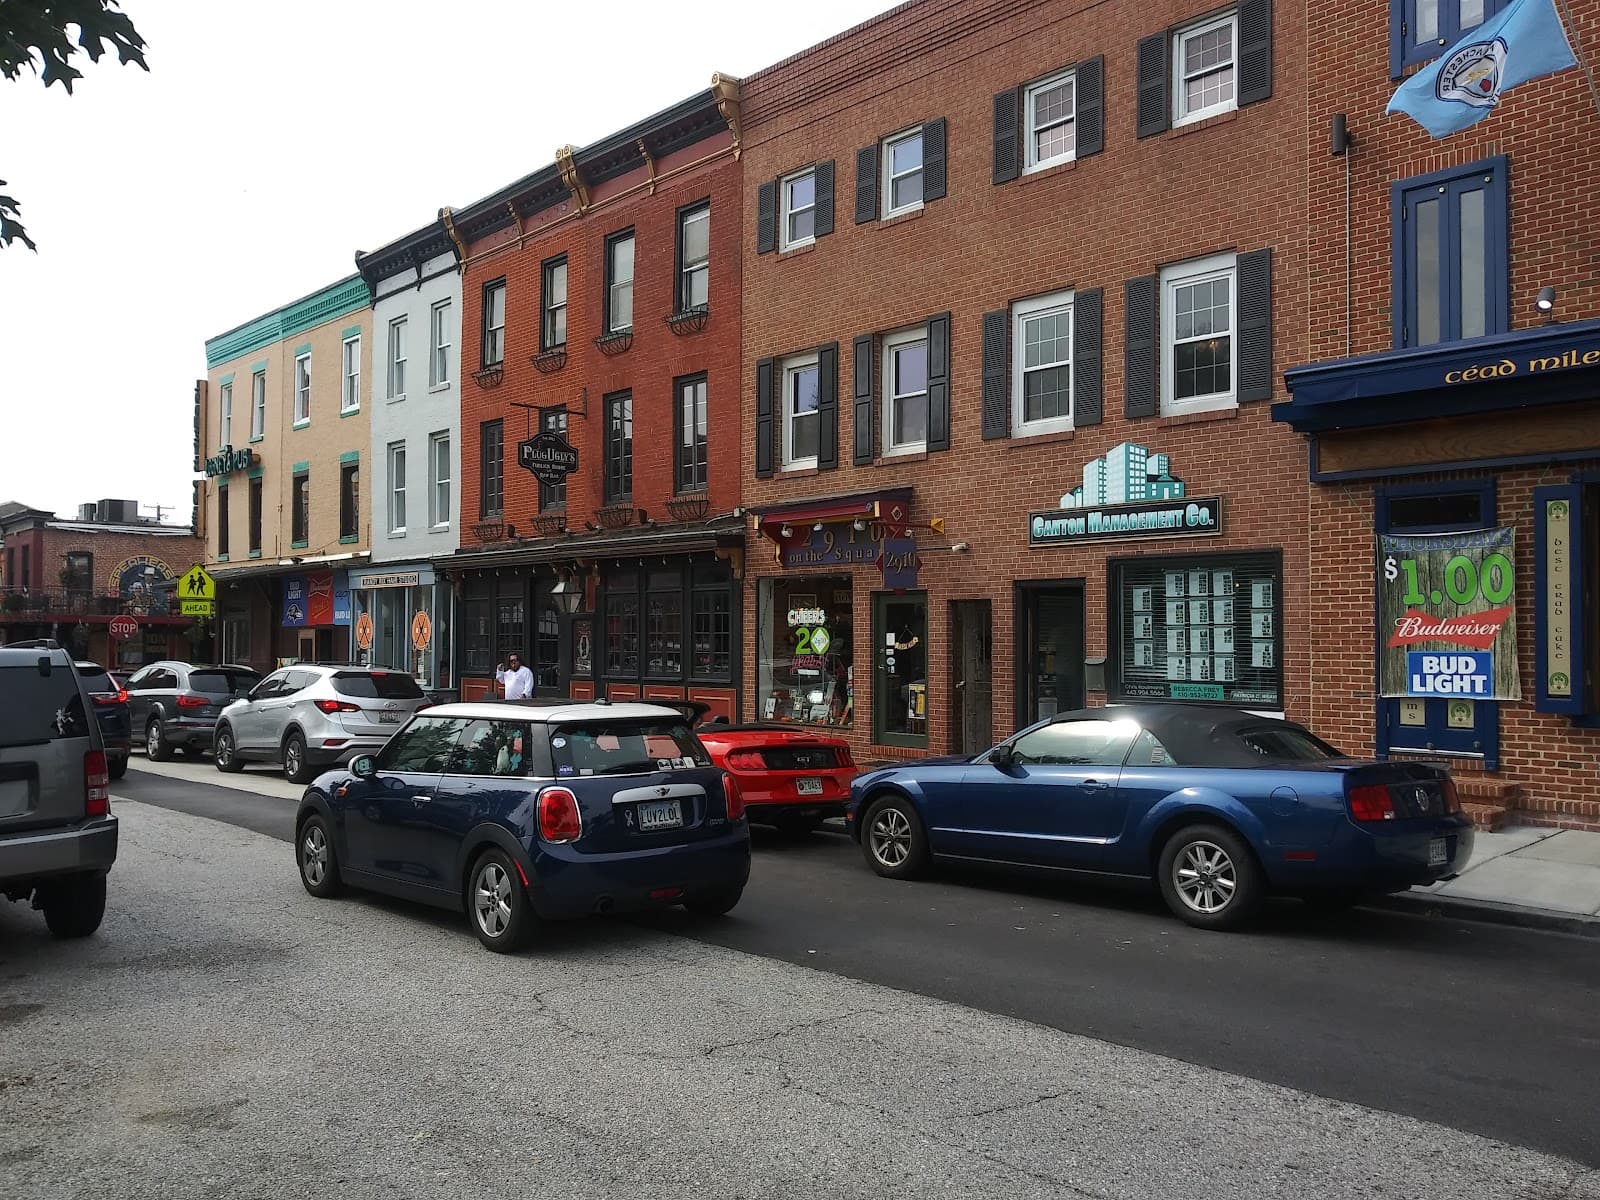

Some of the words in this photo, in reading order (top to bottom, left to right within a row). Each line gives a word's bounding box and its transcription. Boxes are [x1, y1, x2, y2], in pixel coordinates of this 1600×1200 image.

[232, 448, 250, 471] PUB
[1033, 516, 1085, 537] CANTON
[1087, 509, 1184, 533] MANAGEMENT
[789, 553, 802, 563] on
[805, 550, 823, 562] the
[886, 552, 916, 574] 2910
[287, 590, 302, 600] LIGHT
[184, 604, 208, 612] AHEAD
[111, 622, 136, 633] STOP
[788, 609, 825, 627] CHEERS
[1394, 617, 1502, 638] Budweiser
[795, 626, 830, 655] 20
[1422, 656, 1477, 675] BUD
[1412, 674, 1487, 693] LIGHT
